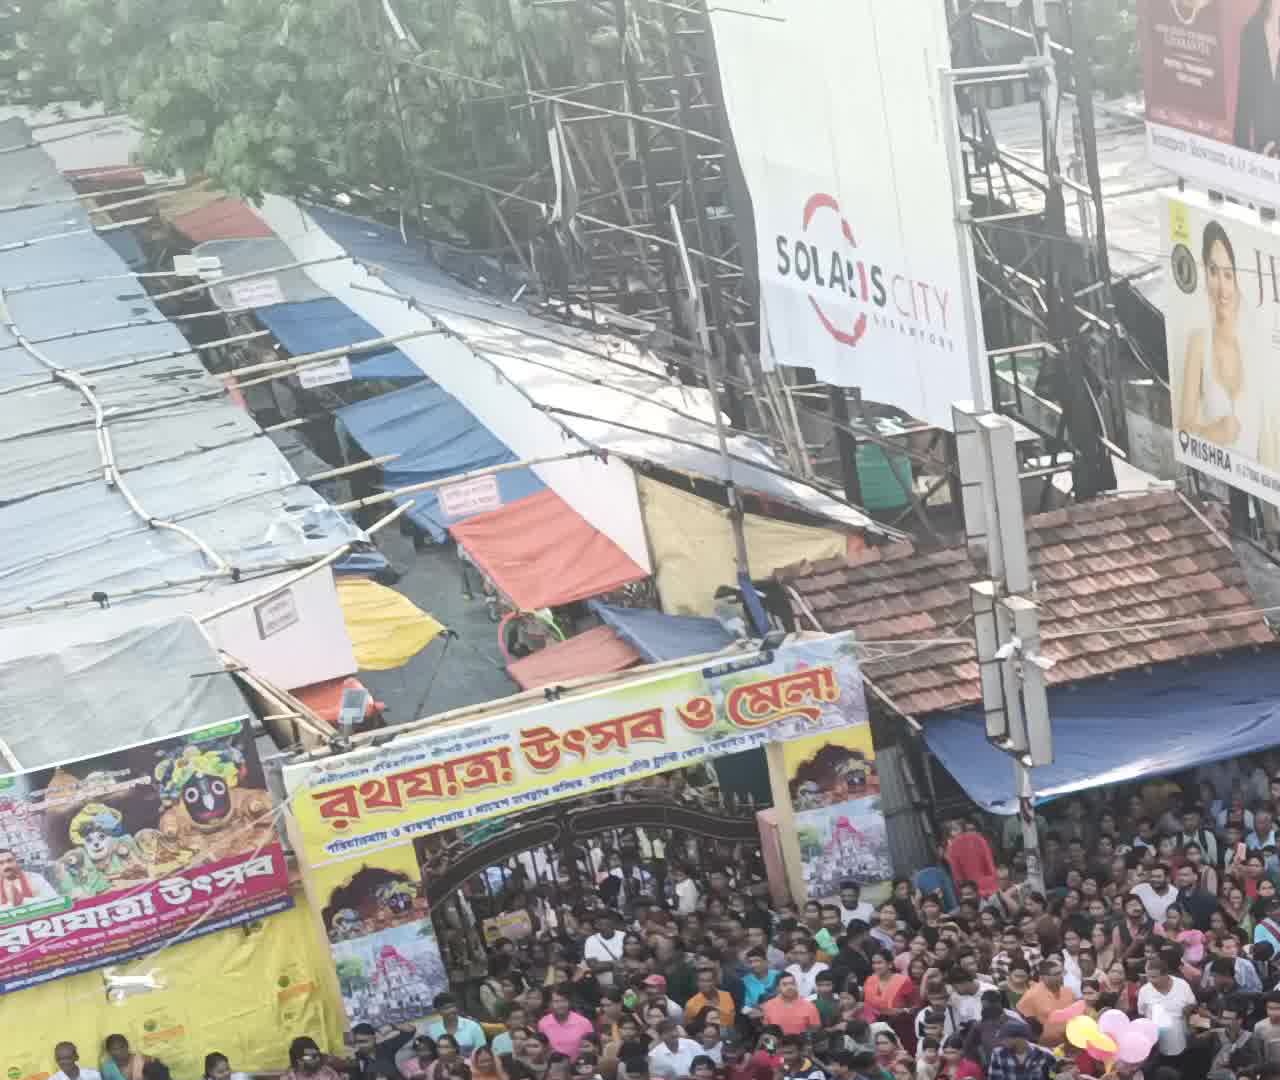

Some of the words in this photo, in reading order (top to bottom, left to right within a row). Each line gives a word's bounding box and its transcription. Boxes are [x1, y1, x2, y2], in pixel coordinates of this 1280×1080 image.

[776, 235, 887, 307] SOLARIS
[891, 275, 953, 329] CITY
[1189, 437, 1232, 473] RISHRA
[311, 746, 513, 830] রথযাত্রা
[519, 707, 665, 769] উৎসব
[677, 697, 715, 731] ও
[726, 665, 840, 729] মেলা
[0, 891, 156, 952] রথযাত্রা
[158, 855, 274, 906] উৎসব
